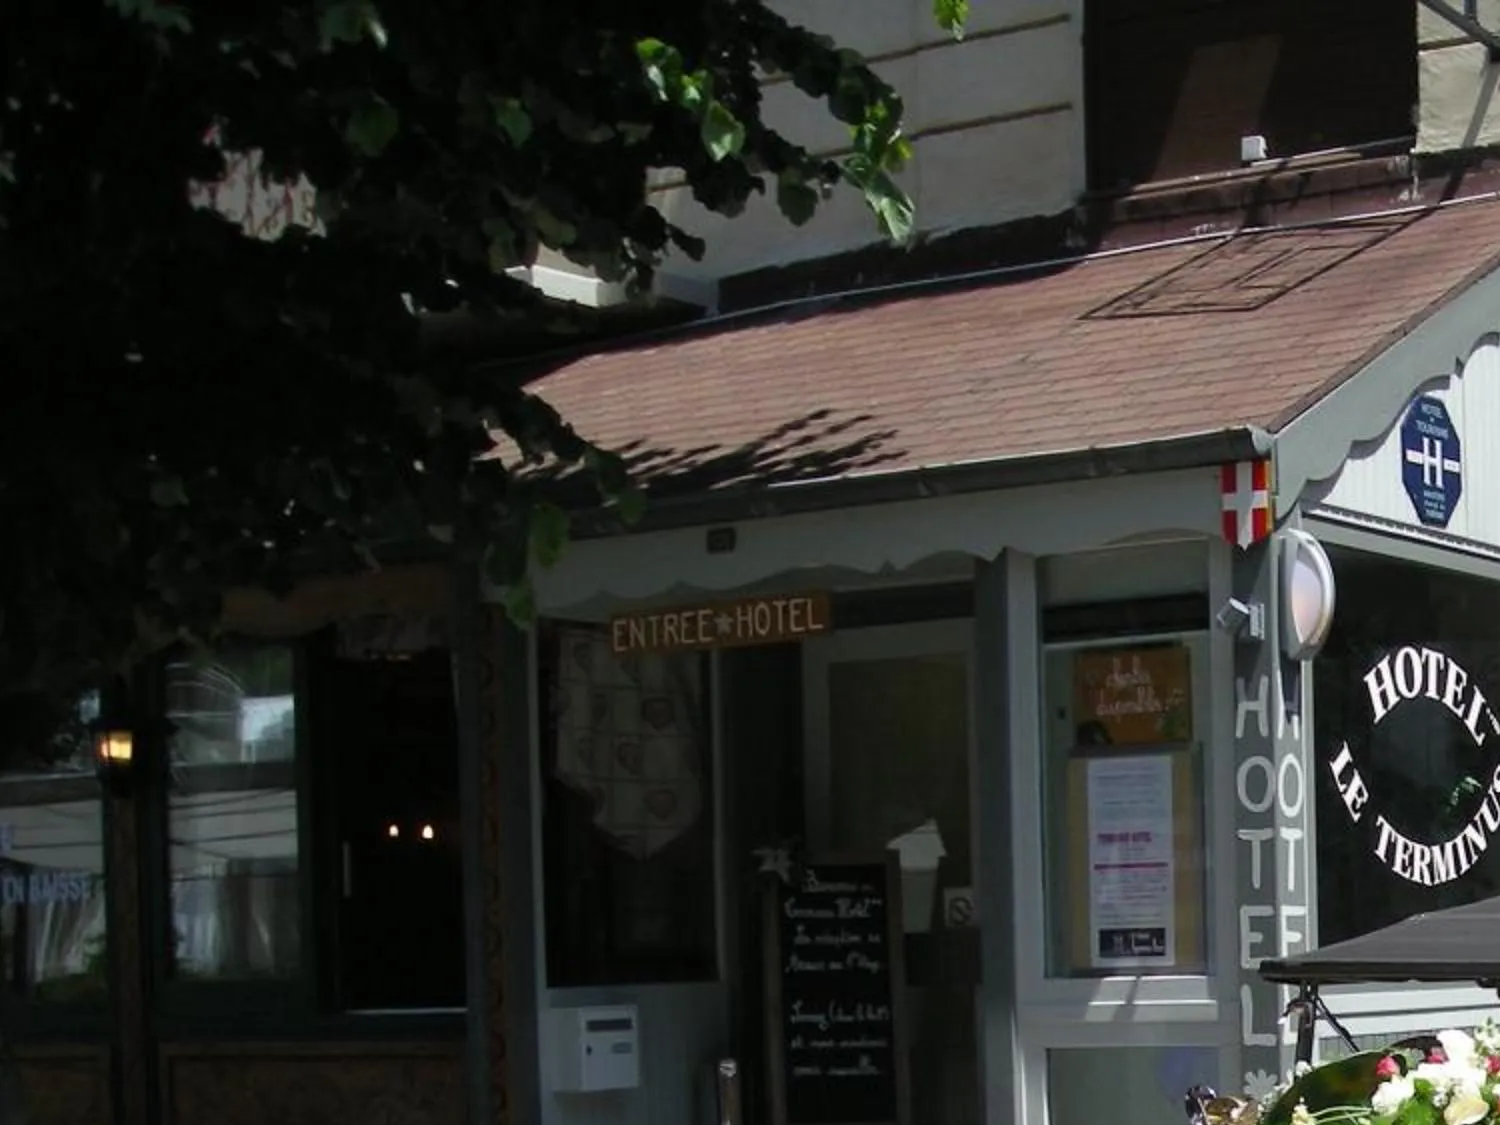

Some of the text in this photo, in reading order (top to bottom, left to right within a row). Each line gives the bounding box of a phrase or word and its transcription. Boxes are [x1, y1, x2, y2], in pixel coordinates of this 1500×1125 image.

[612, 597, 825, 652] ENTREE HOTEL
[1363, 645, 1486, 747] HOTEL
[1329, 740, 1370, 822] LE
[1235, 674, 1277, 1046] HOTEL
